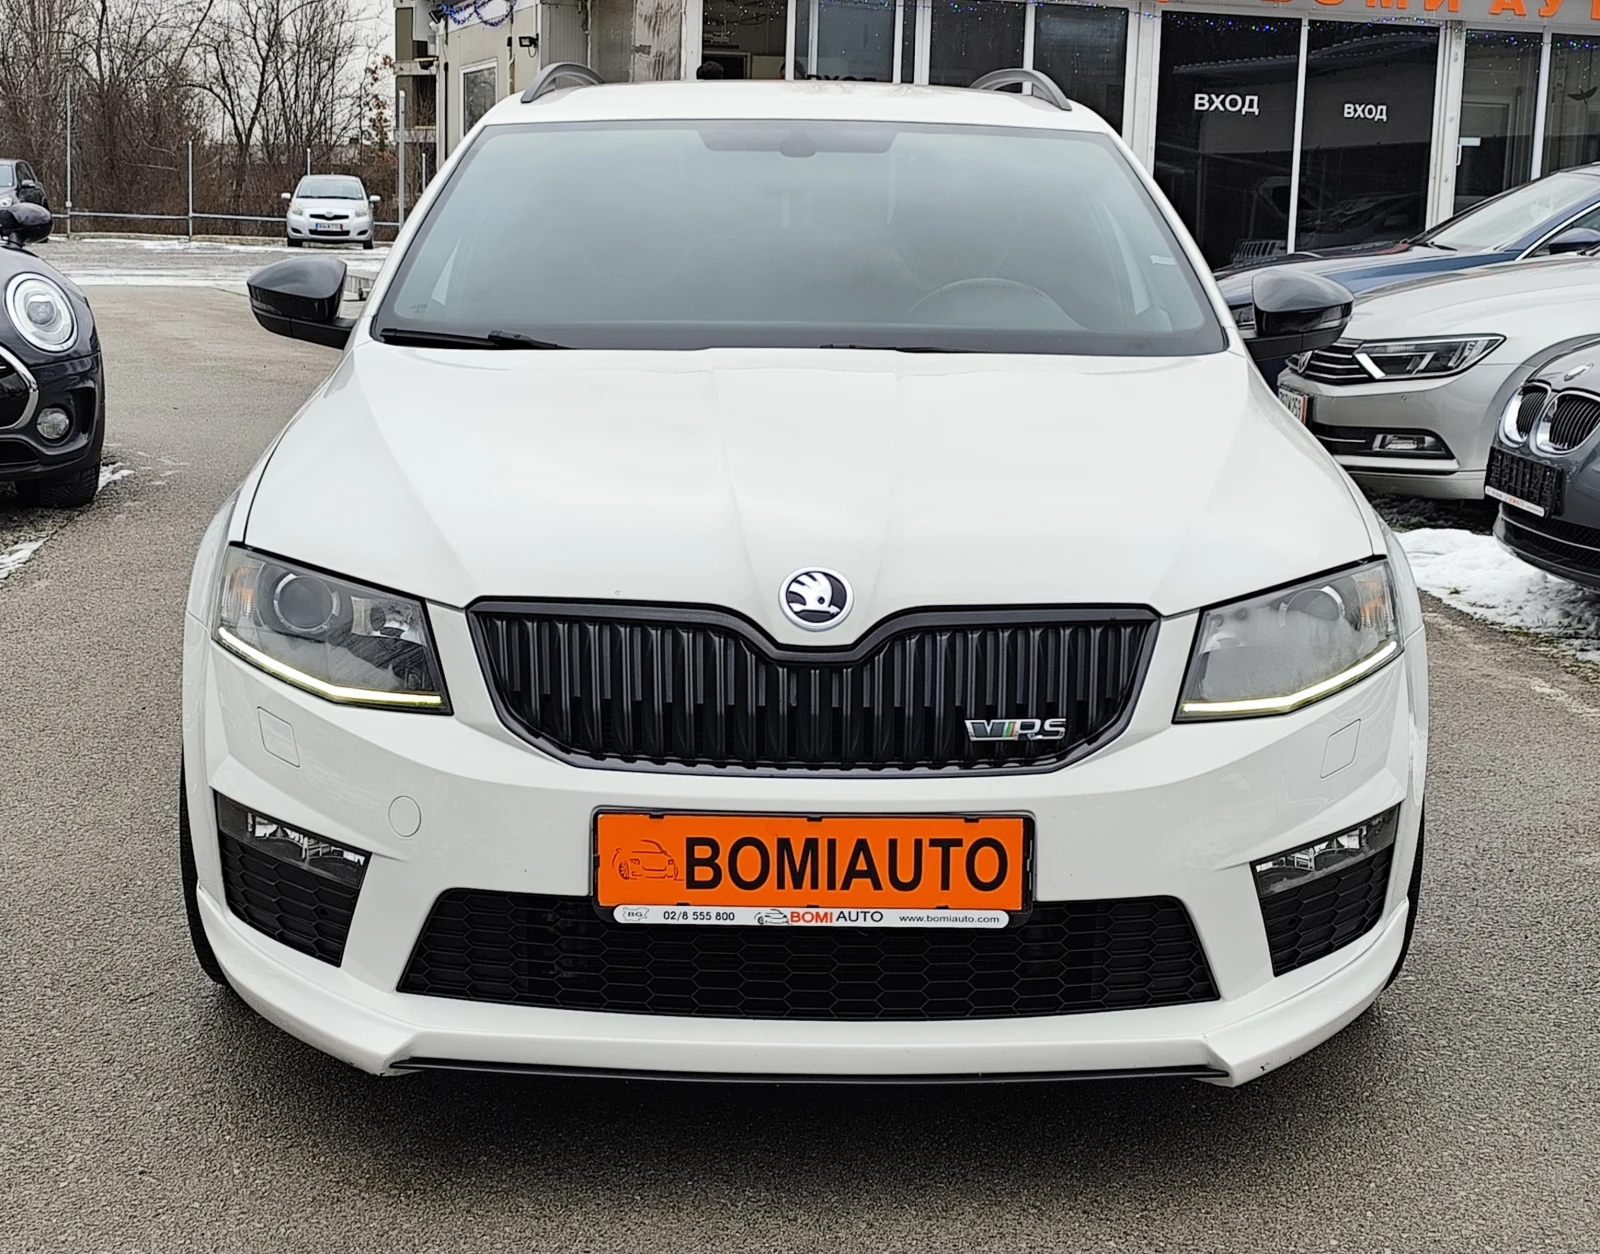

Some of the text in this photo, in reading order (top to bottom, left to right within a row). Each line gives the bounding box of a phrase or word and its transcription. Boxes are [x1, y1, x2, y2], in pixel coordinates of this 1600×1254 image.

[1194, 93, 1259, 116] ВХОД
[1343, 103, 1388, 122] ВХОД
[685, 836, 1009, 892] BOMIAUTO
[663, 910, 735, 921] 02/8 555 800
[789, 910, 884, 923] BOMI AUTO
[899, 914, 1000, 924] www.bomiauto.com
